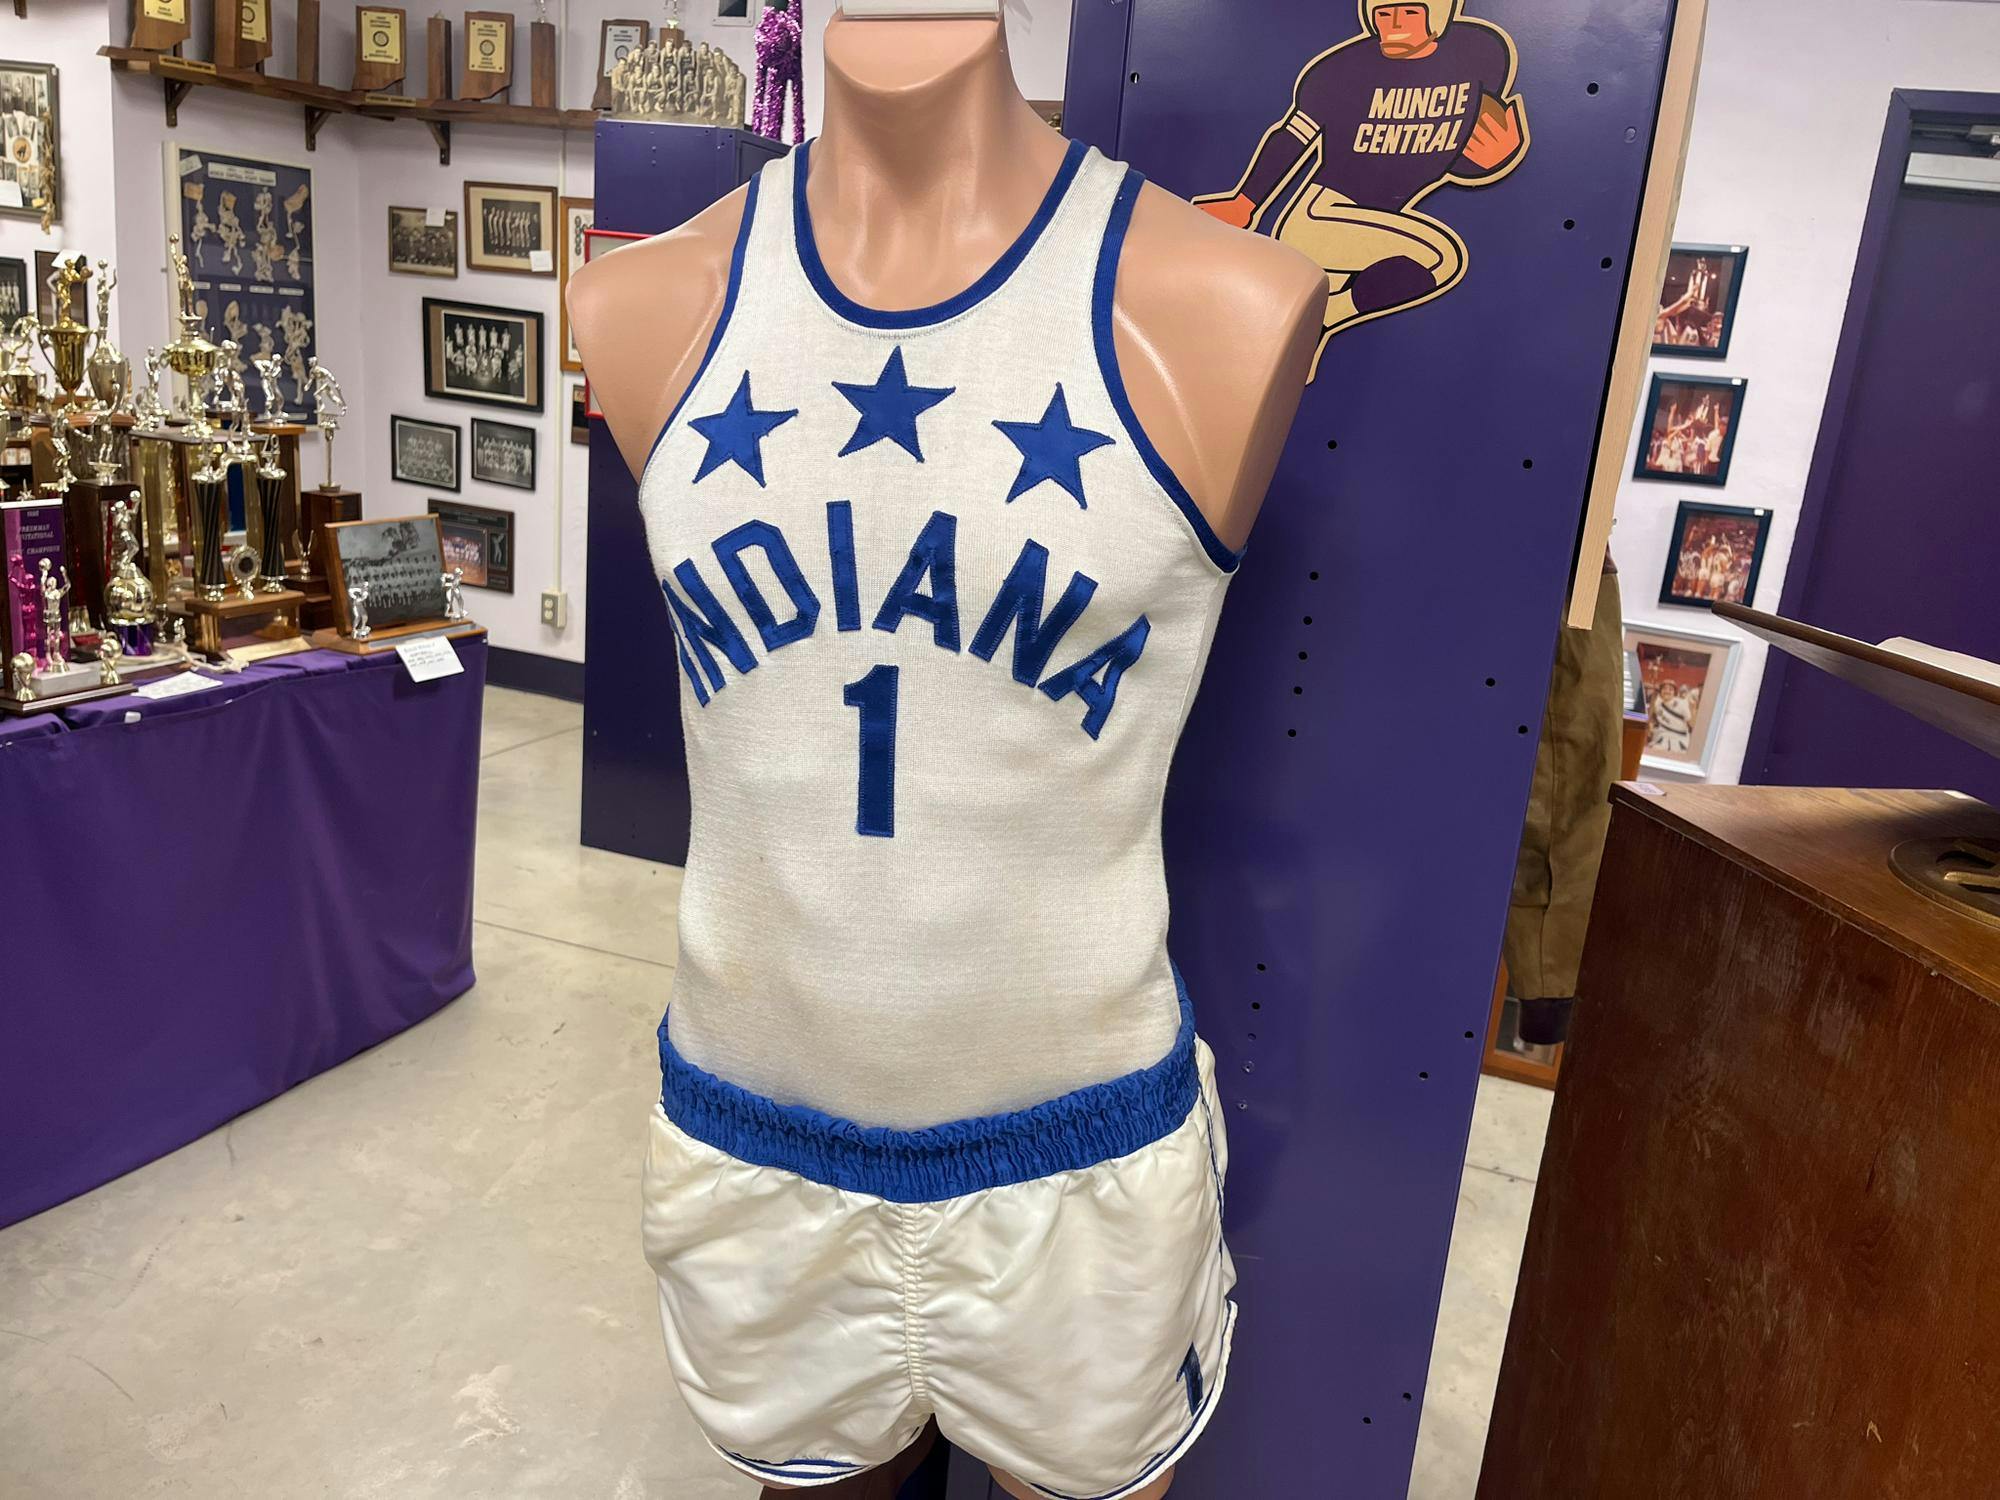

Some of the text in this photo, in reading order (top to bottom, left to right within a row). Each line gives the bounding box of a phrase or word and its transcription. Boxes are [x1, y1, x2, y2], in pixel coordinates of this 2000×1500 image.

[1353, 119, 1463, 154] CENTRAL
[1367, 82, 1470, 119] MUNCIE
[662, 500, 1152, 741] INDIANA
[843, 664, 899, 838] 1
